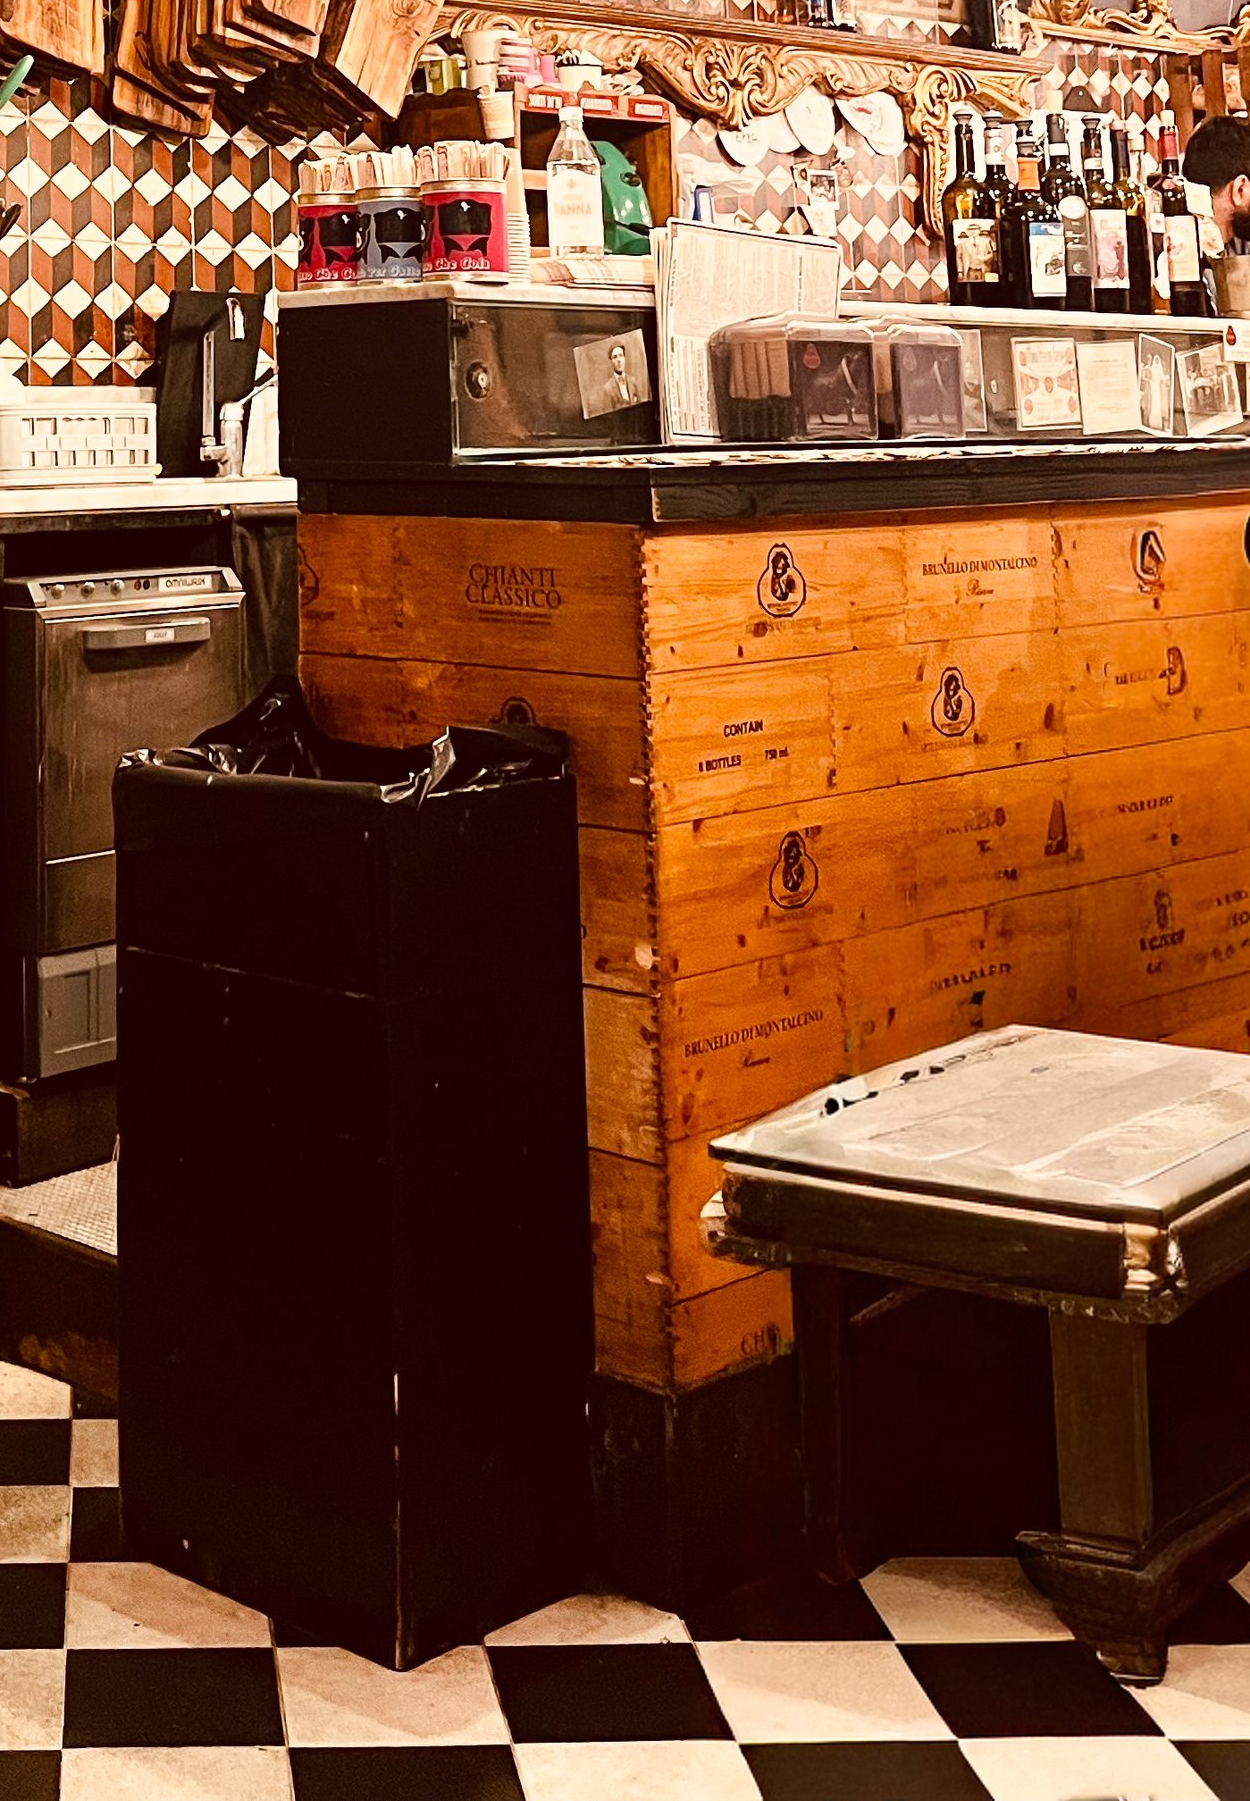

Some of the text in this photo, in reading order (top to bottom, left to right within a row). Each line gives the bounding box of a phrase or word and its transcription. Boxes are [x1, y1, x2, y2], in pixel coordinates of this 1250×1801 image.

[469, 562, 556, 588] CHIANTI
[922, 560, 968, 576] BRUNELLO
[980, 556, 1038, 572] MONTALCINO
[465, 582, 563, 609] CLASSICO
[723, 719, 763, 737] CONTAIN
[705, 755, 742, 771] BOTTLES
[765, 749, 777, 760] 750
[684, 1030, 740, 1058] BRUNELLO
[753, 1009, 823, 1039] MONTALCINO
